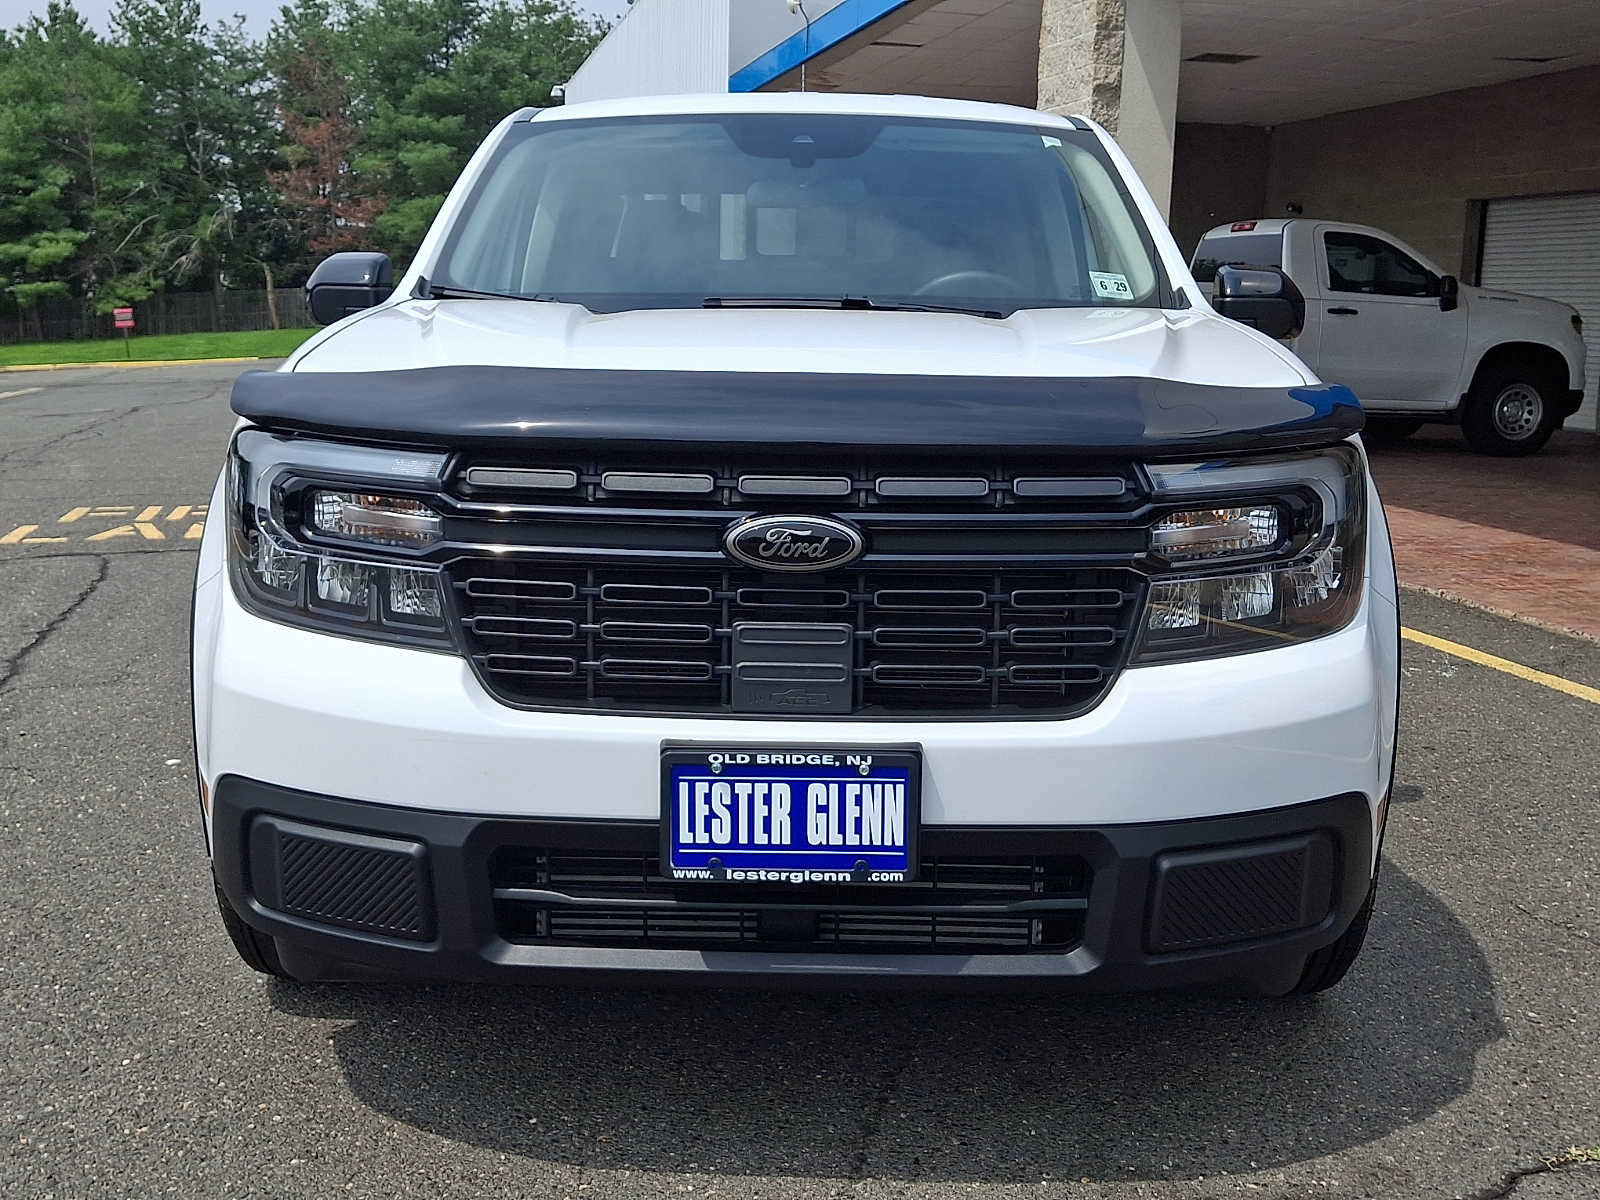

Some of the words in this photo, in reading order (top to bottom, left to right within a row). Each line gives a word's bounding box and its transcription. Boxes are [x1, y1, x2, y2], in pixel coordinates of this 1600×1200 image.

[1099, 280, 1108, 291] 6
[1113, 281, 1128, 292] 29
[758, 527, 830, 558] Ford
[707, 753, 750, 765] OLD
[756, 754, 840, 767] BRIDGE,
[846, 754, 872, 767] NJ
[678, 781, 791, 845] LESTER
[806, 782, 905, 847] GLENN
[726, 868, 851, 883] lesterglenn
